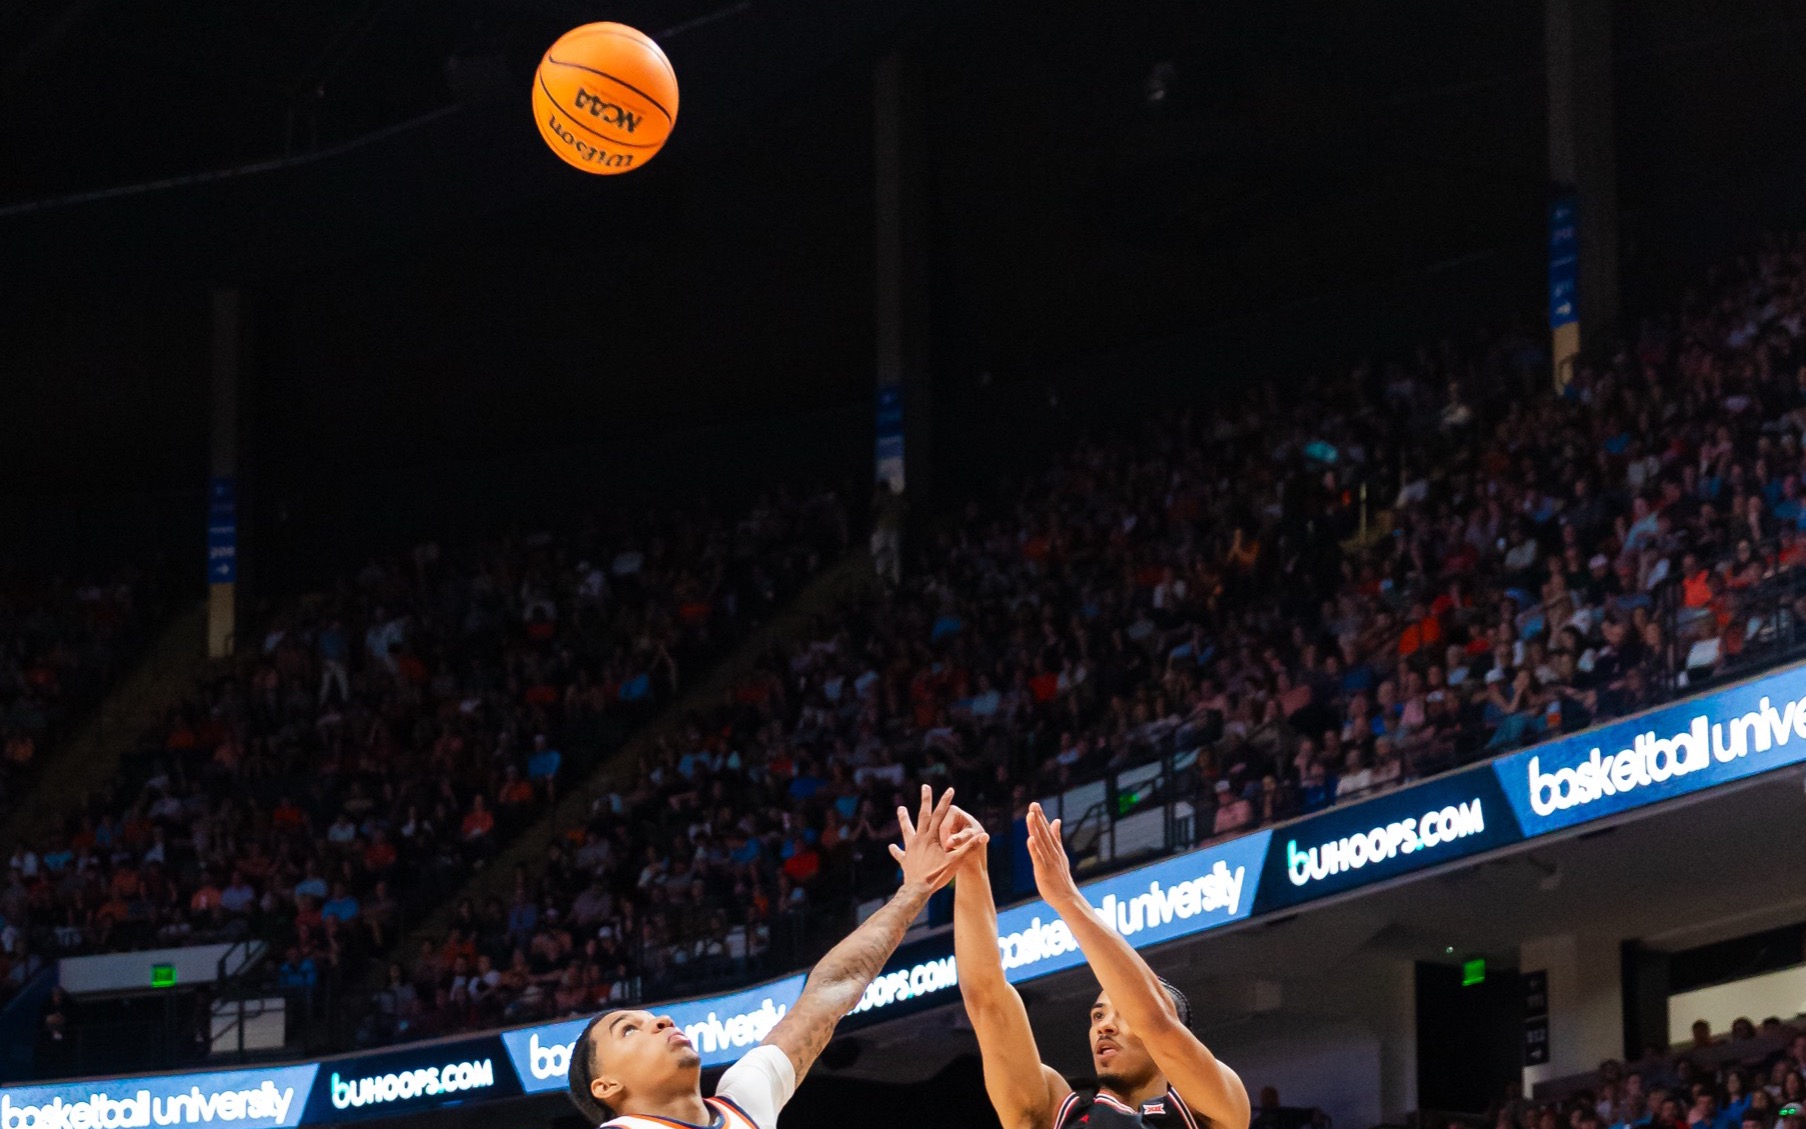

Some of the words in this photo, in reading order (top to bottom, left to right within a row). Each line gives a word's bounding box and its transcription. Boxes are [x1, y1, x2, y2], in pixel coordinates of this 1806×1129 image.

[575, 87, 643, 133] NCAA
[1528, 715, 1710, 816] basketball
[1117, 860, 1246, 935] university
[152, 1081, 294, 1125] university
